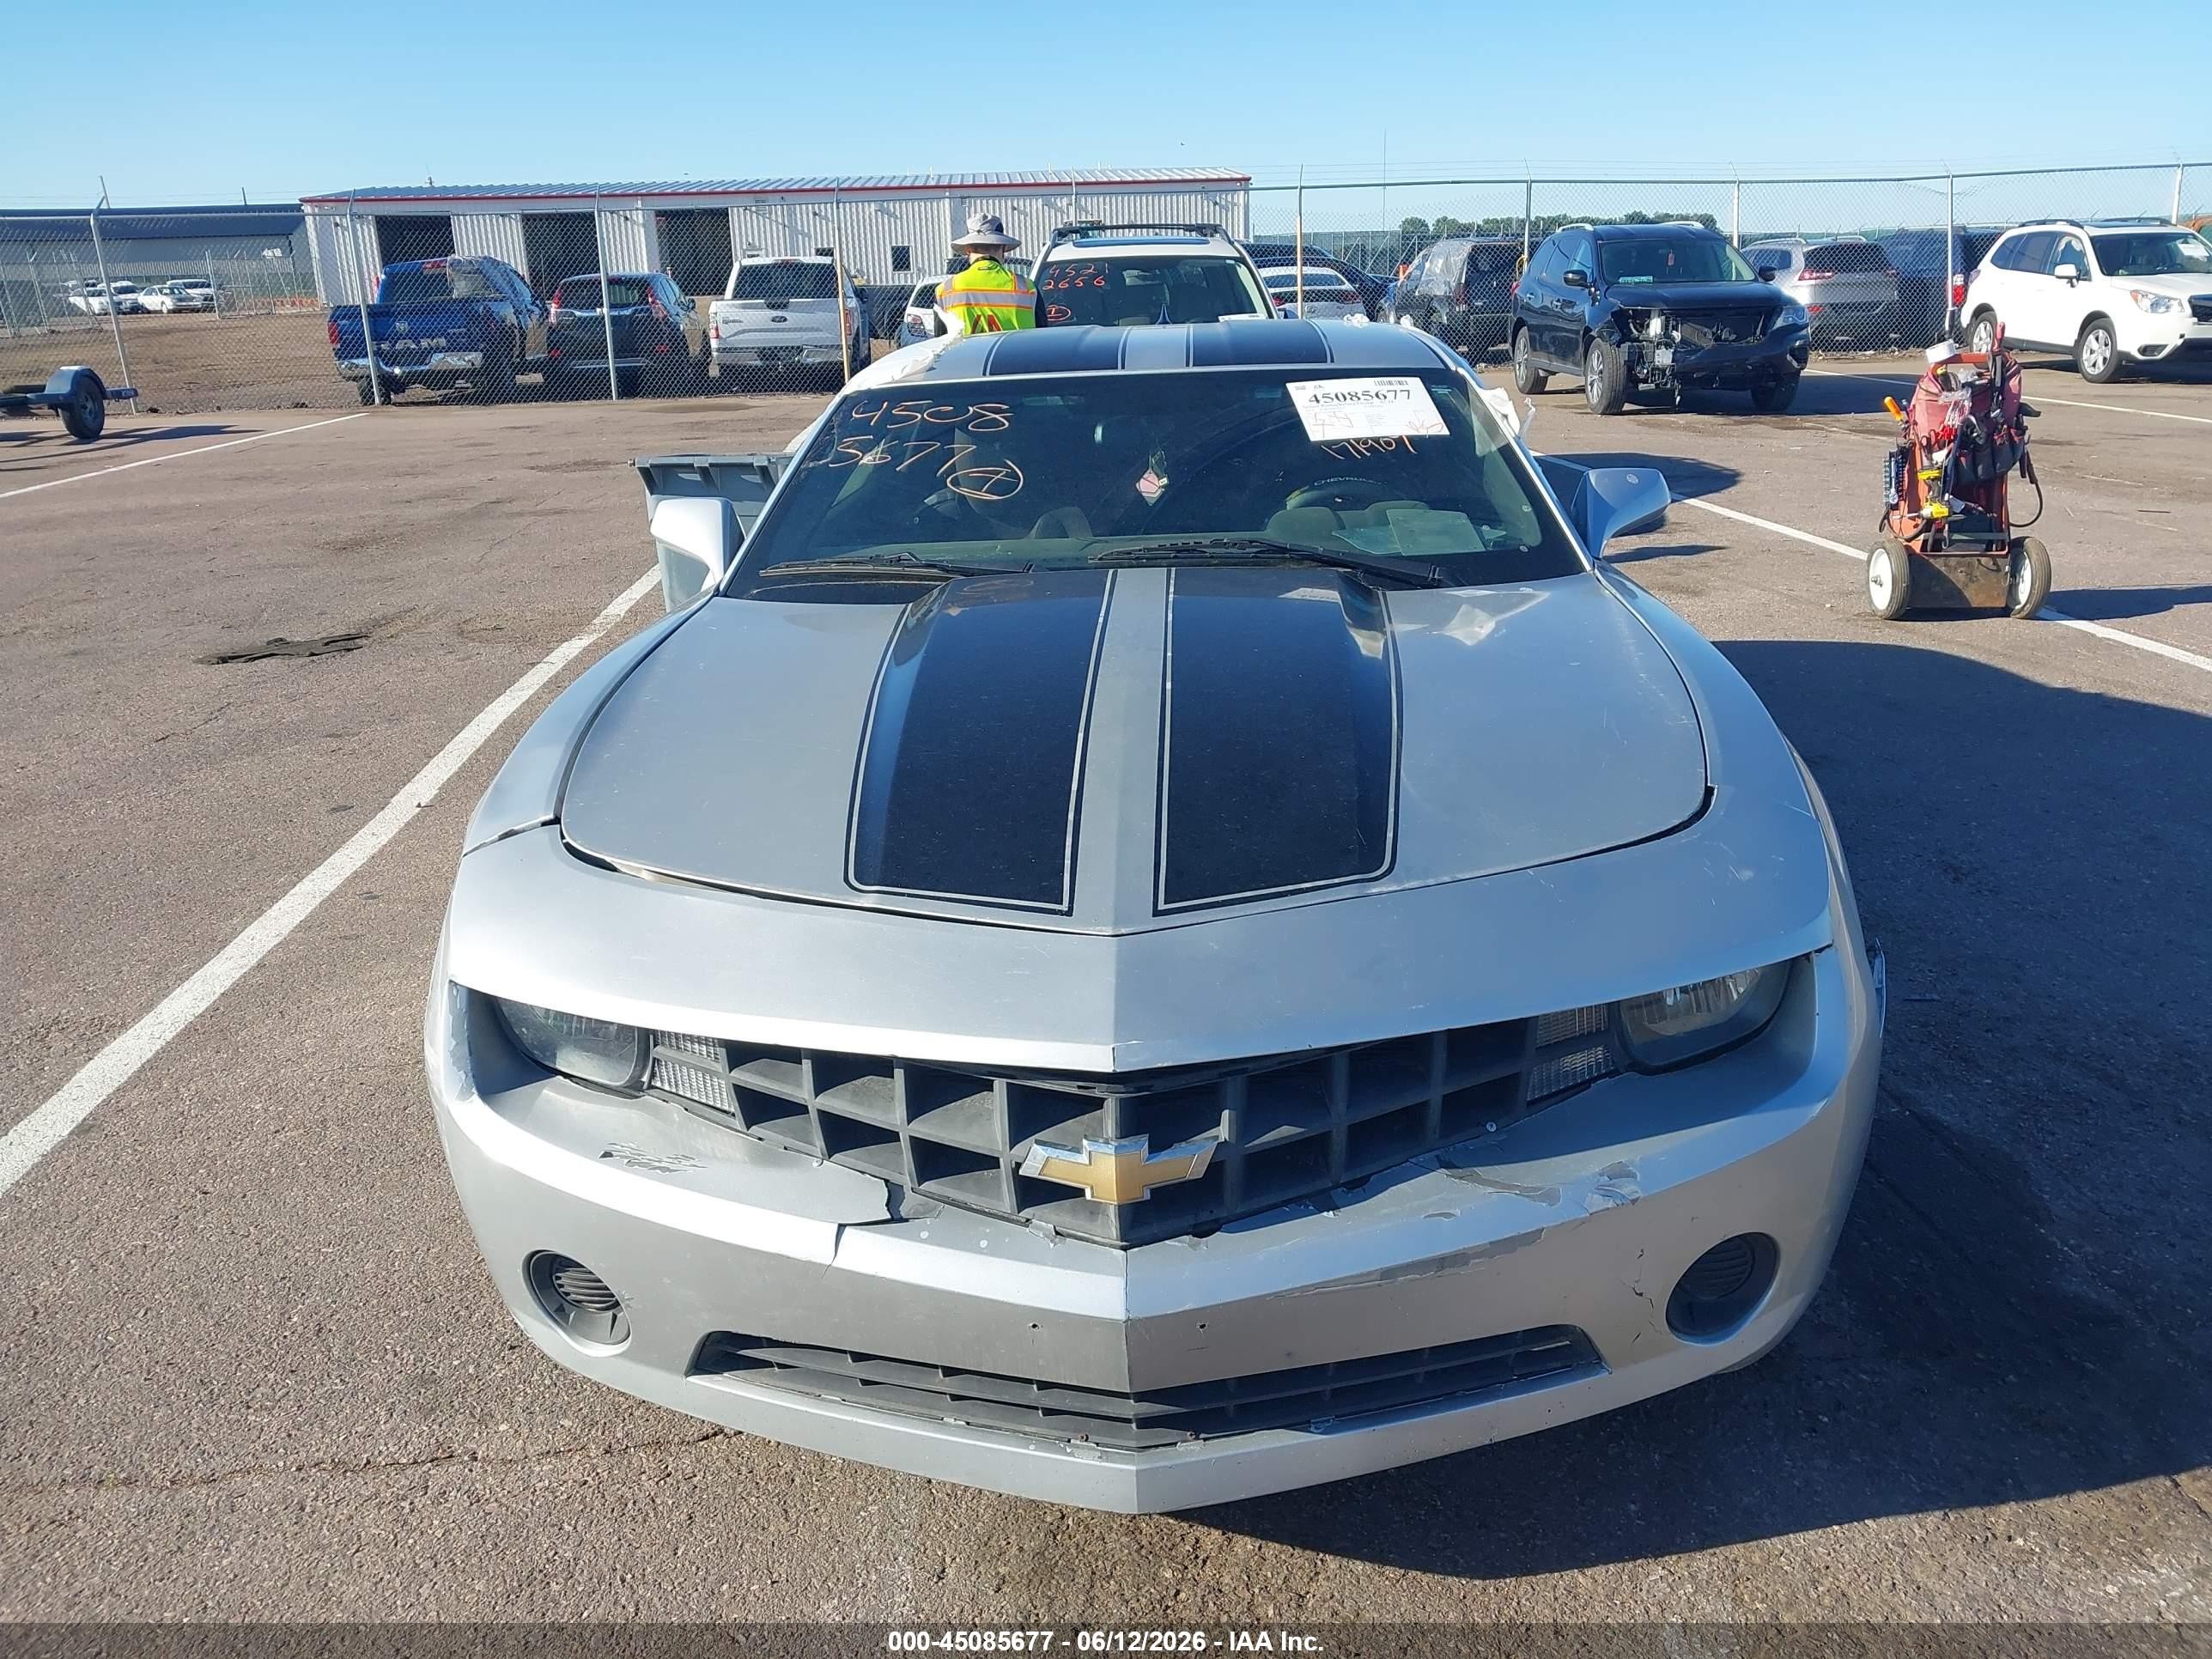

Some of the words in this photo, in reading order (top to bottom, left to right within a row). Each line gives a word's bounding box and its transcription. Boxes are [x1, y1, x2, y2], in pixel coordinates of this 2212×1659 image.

[1049, 263, 1109, 277] 4521
[1042, 276, 1105, 290] 2656
[1308, 389, 1411, 404] 45085677
[829, 435, 977, 477] 5677
